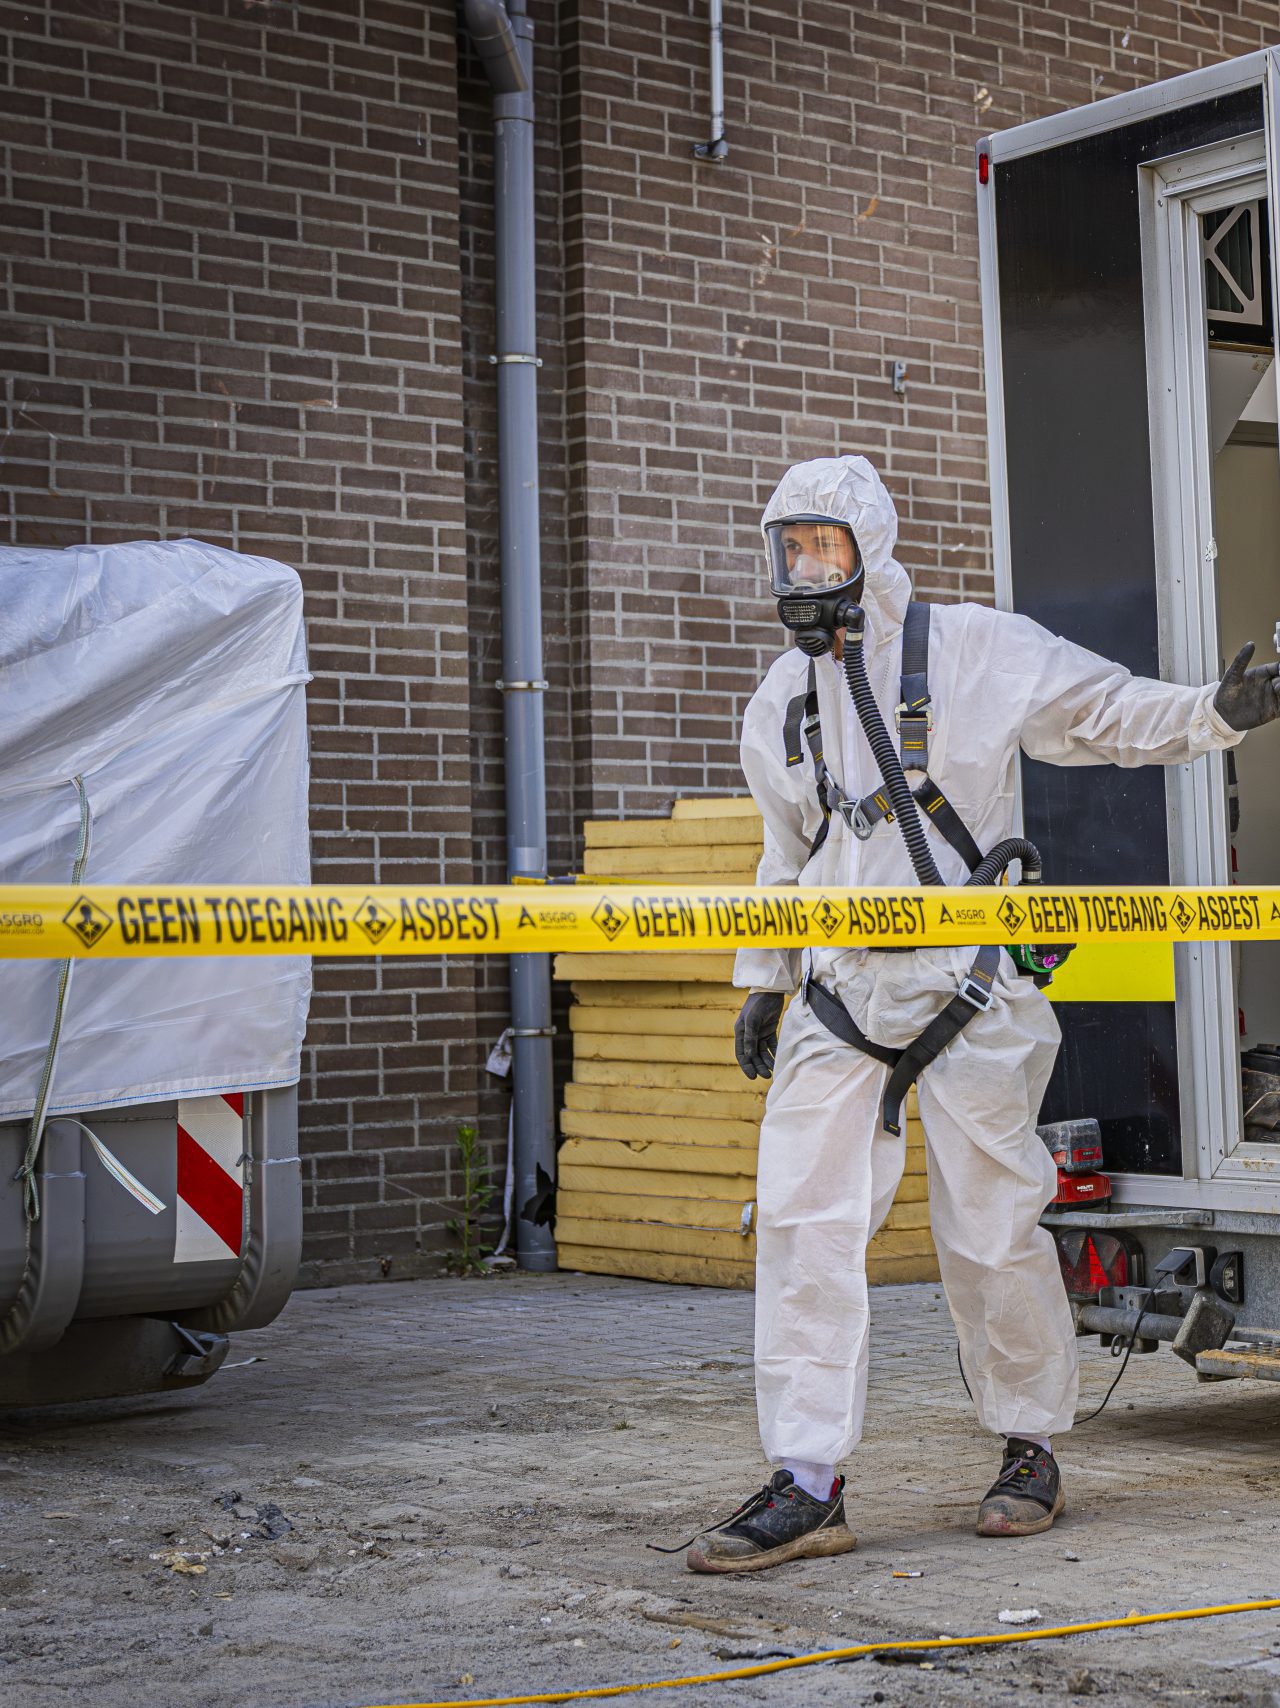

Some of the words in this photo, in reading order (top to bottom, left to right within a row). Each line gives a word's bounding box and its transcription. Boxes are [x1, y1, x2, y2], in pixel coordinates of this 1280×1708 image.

[0, 913, 43, 927] SGRO
[118, 896, 200, 945] GEEN
[205, 896, 348, 943] TOEGANG
[399, 896, 500, 942] ASBEST
[632, 895, 694, 938] GEEN
[699, 895, 808, 937] TOEGANG
[847, 895, 926, 935] ASBEST
[956, 909, 985, 920] ASGRO
[1028, 895, 1079, 933] GEEN
[1079, 895, 1167, 932] TOEGANG
[1197, 895, 1260, 930] ASBEST
